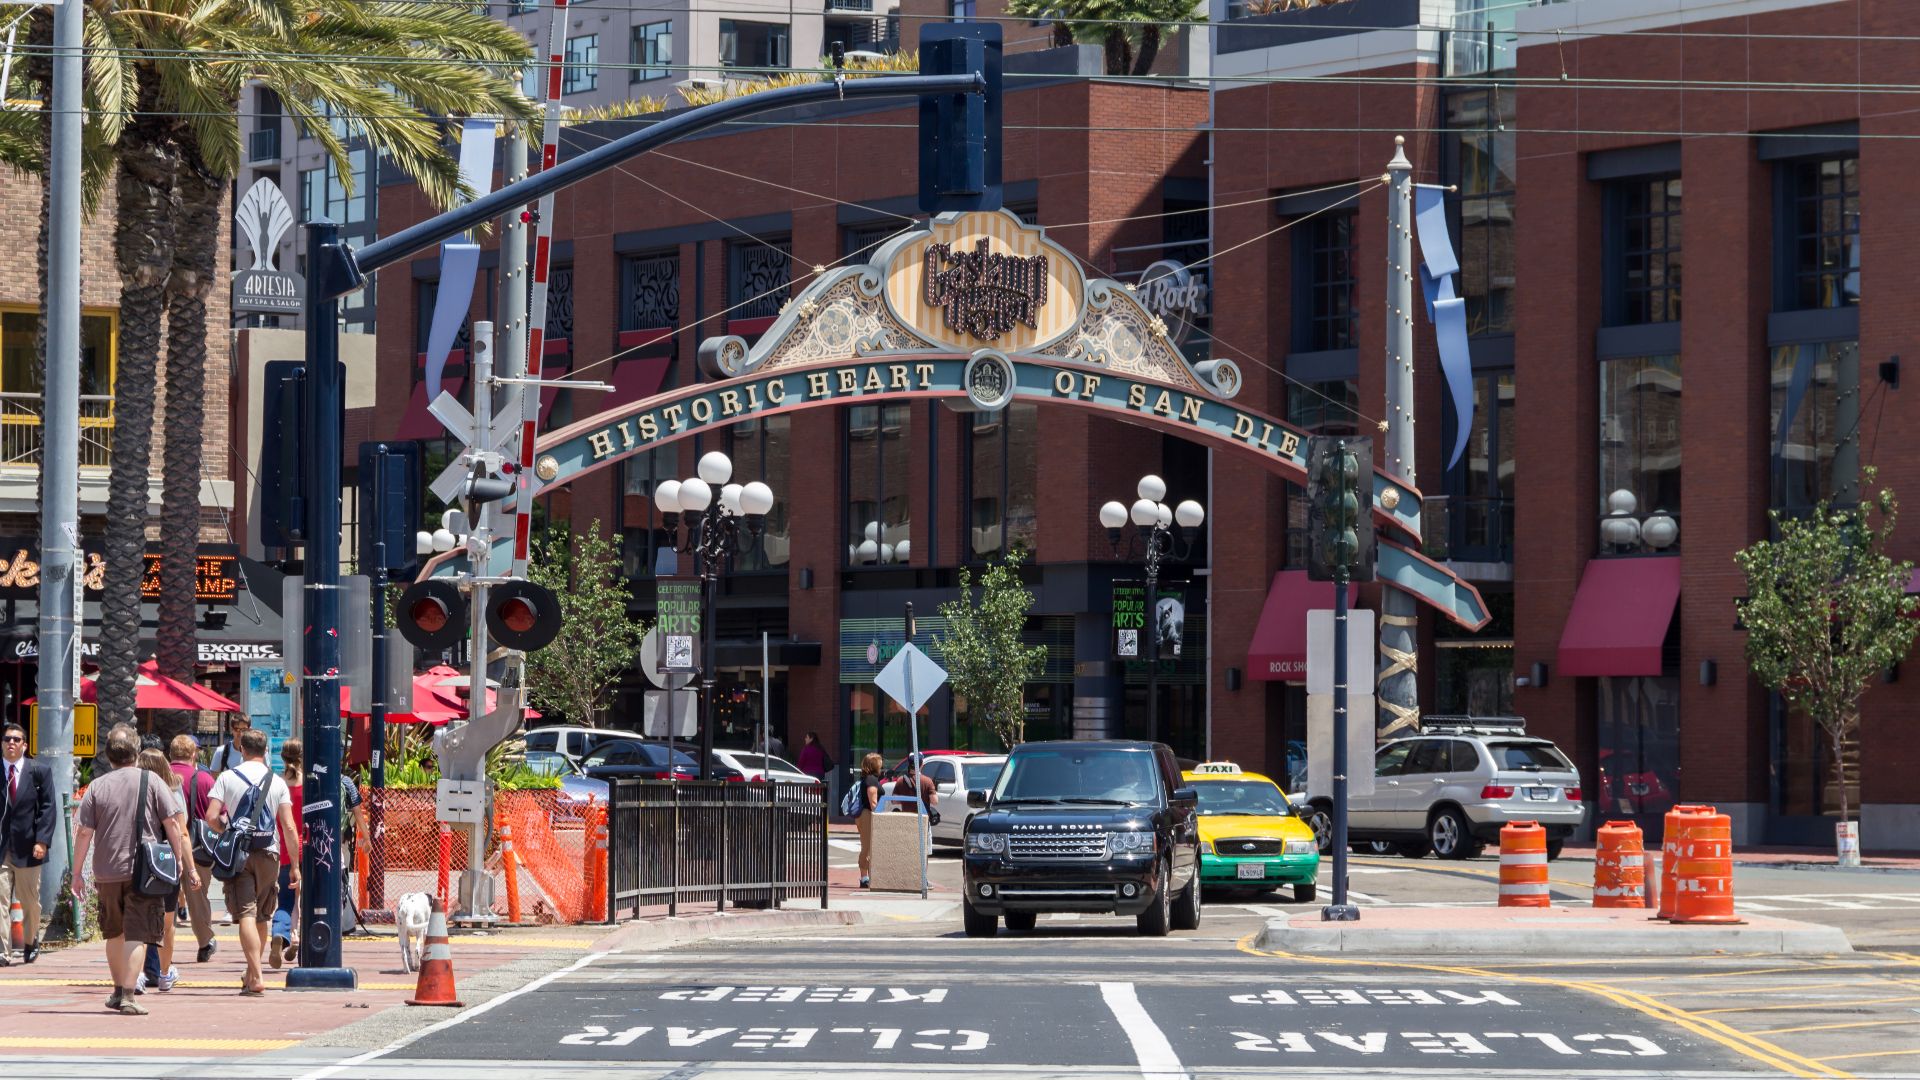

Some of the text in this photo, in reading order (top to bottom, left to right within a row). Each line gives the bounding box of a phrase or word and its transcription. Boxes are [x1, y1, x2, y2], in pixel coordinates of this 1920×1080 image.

[923, 236, 1048, 308] Gaslamp
[244, 275, 296, 297] ARTESIA
[1153, 275, 1199, 316] Rock
[588, 364, 1300, 459] HISTORIC HEART OF SAN DIE
[194, 561, 222, 577] HE
[657, 585, 701, 594] CELEBRATING
[657, 600, 701, 613] POPULAR
[1113, 600, 1145, 612] POPULAR
[657, 615, 701, 633] ARTS
[1112, 611, 1145, 628] ARTS
[197, 643, 275, 654] EXOTIC
[197, 652, 281, 662] DRINKS
[1269, 661, 1293, 673] ROCK
[1203, 765, 1233, 773] TAXI
[659, 986, 949, 1003] KEEP
[1229, 989, 1522, 1006] KEEP
[558, 1025, 990, 1051] CLEAR
[1233, 1030, 1668, 1057] CLEAR
